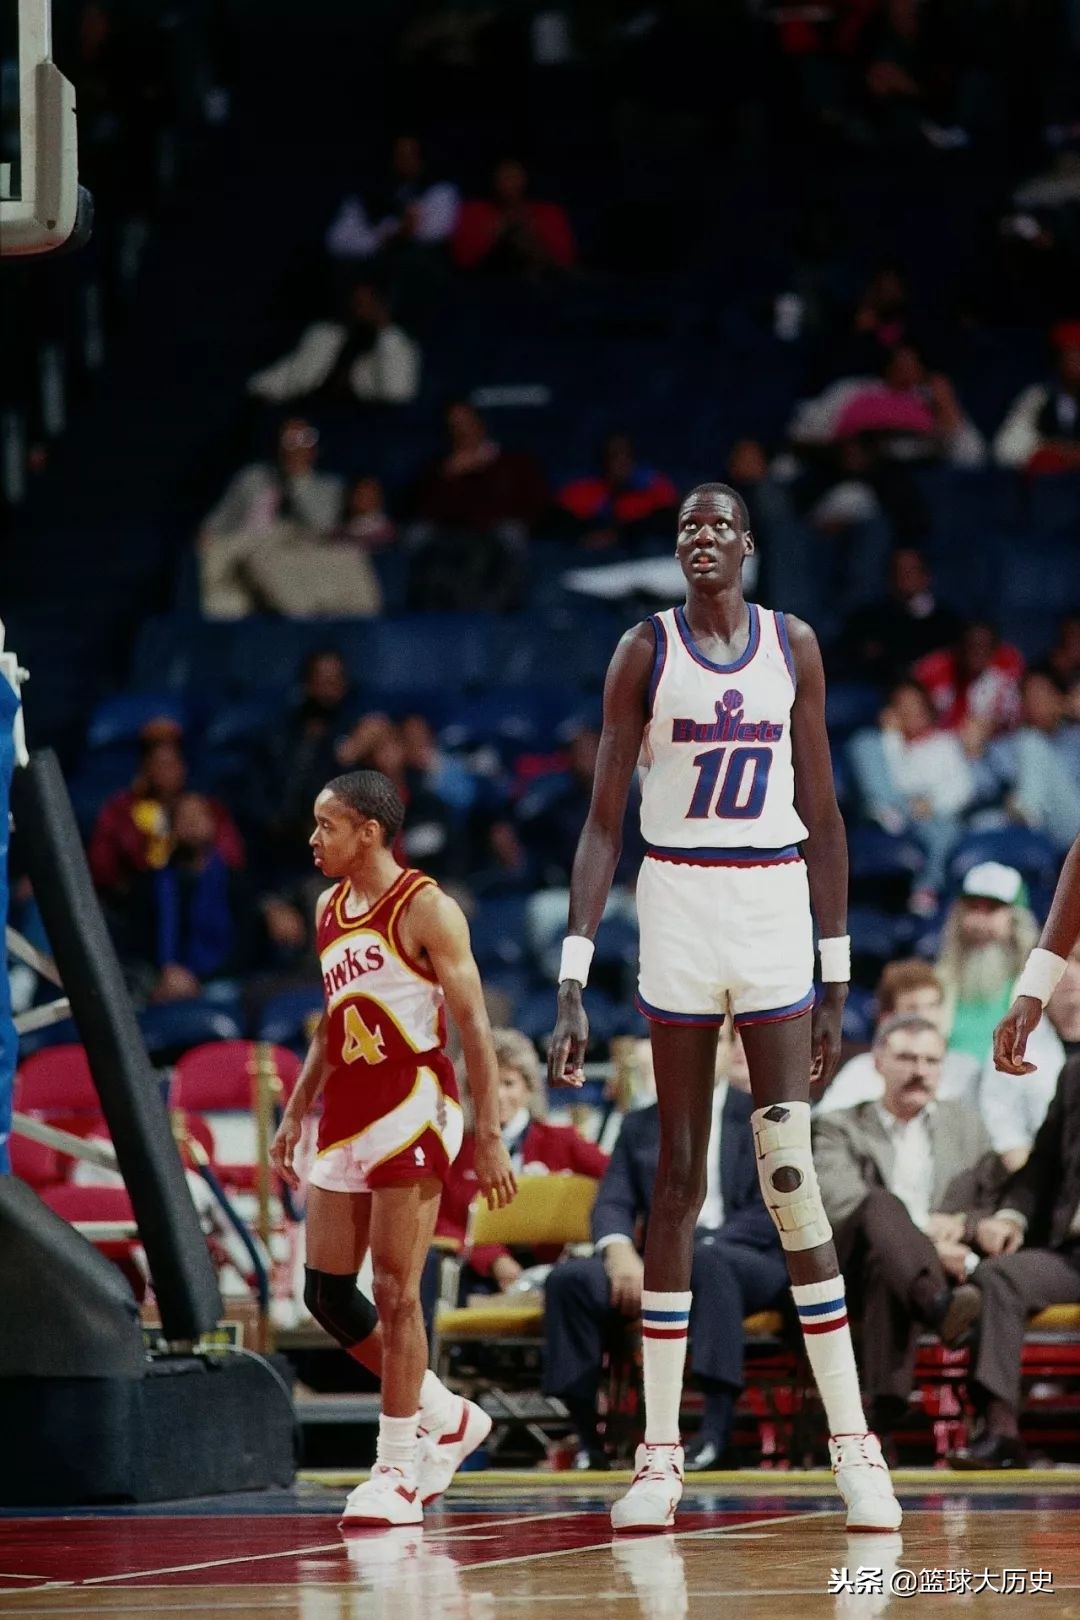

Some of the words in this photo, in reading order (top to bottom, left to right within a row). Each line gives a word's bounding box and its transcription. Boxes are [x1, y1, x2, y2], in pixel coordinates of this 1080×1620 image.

[672, 701, 783, 743] Bullets
[684, 747, 773, 819] 10
[341, 1004, 388, 1065] 4
